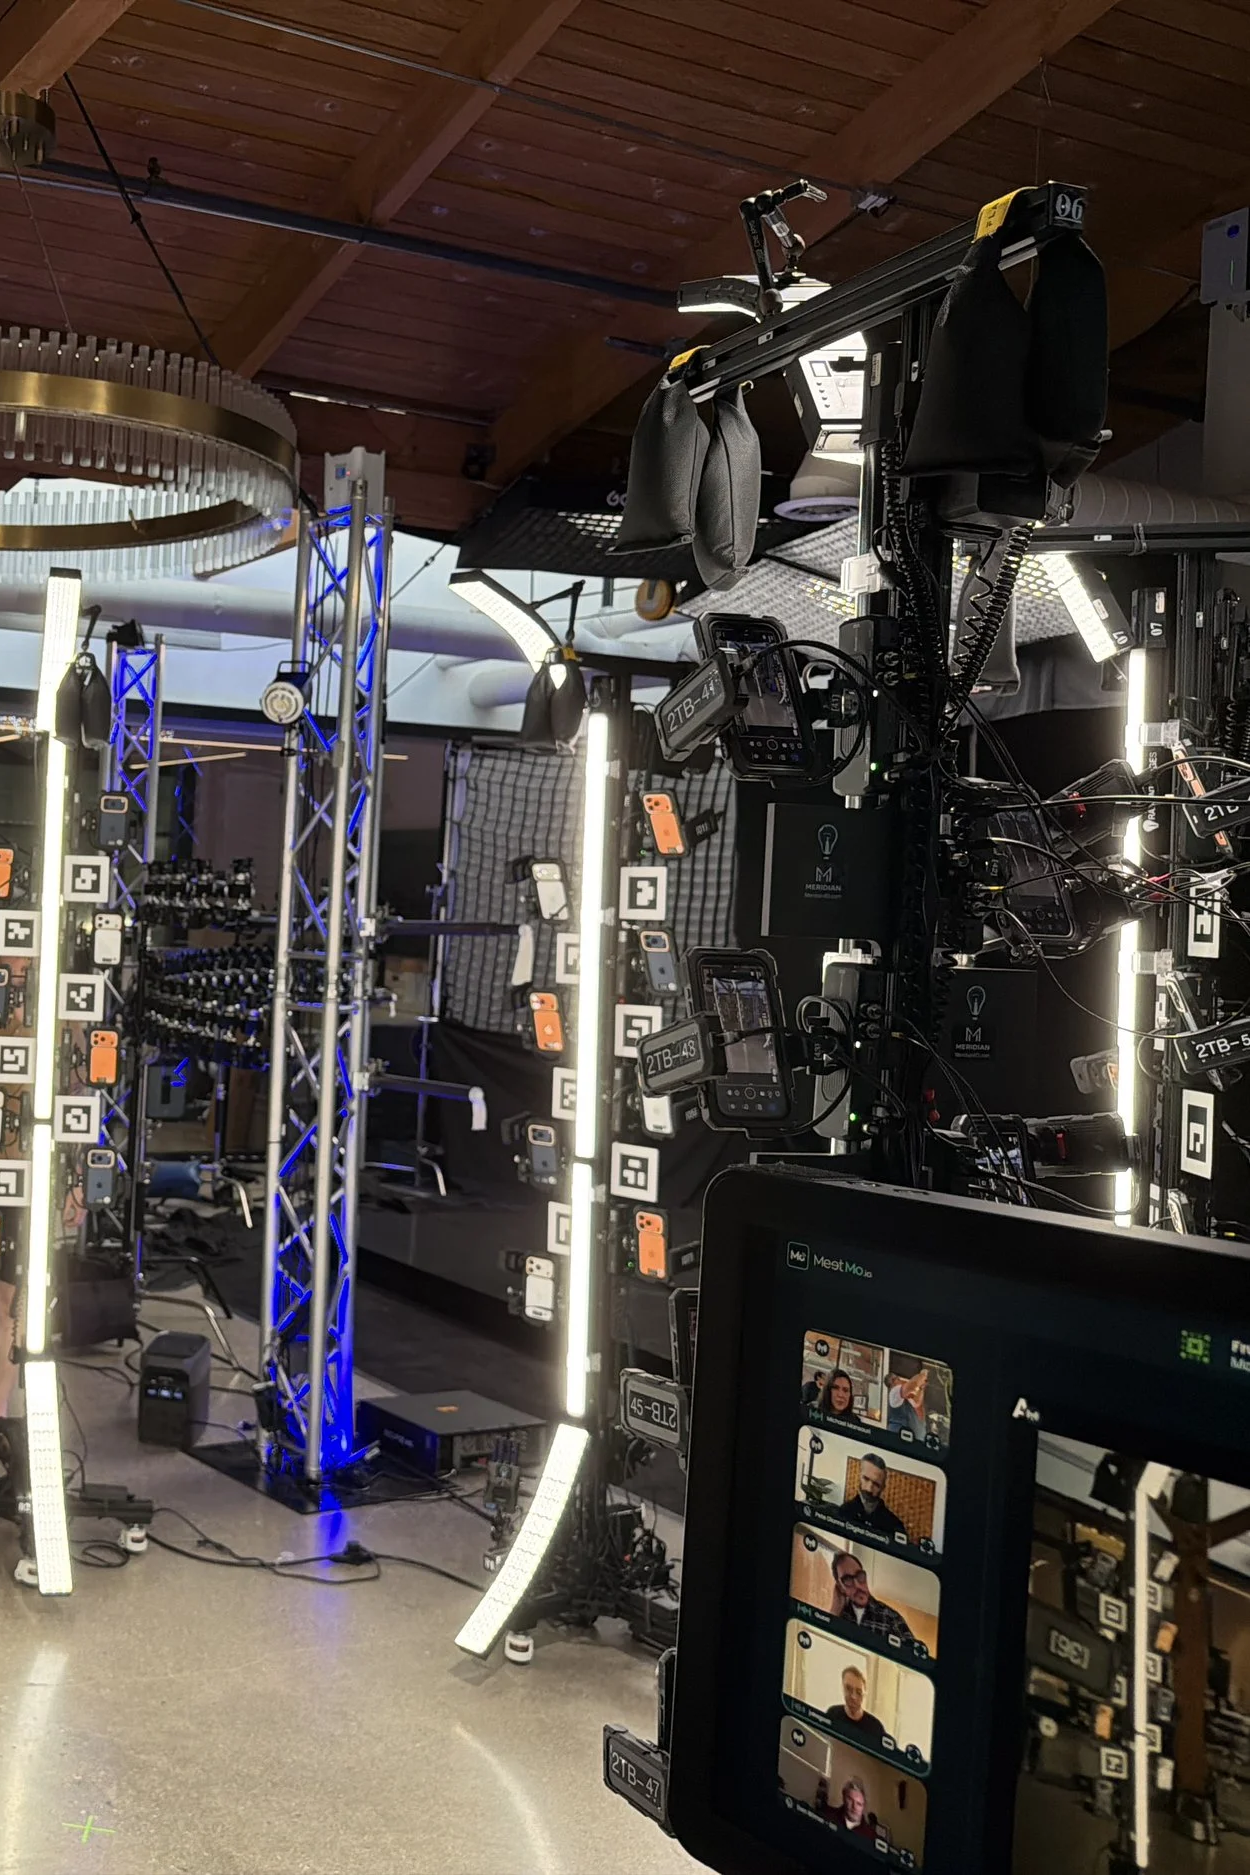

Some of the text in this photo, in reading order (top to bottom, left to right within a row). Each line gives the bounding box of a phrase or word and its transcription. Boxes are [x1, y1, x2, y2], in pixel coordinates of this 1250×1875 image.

[1056, 194, 1085, 220] 06
[1150, 622, 1163, 636] 07
[1112, 630, 1128, 645] 07
[805, 883, 842, 892] MERIDIAN
[955, 1043, 990, 1051] MERIDIAN
[611, 1752, 660, 1798] 2TB-47
